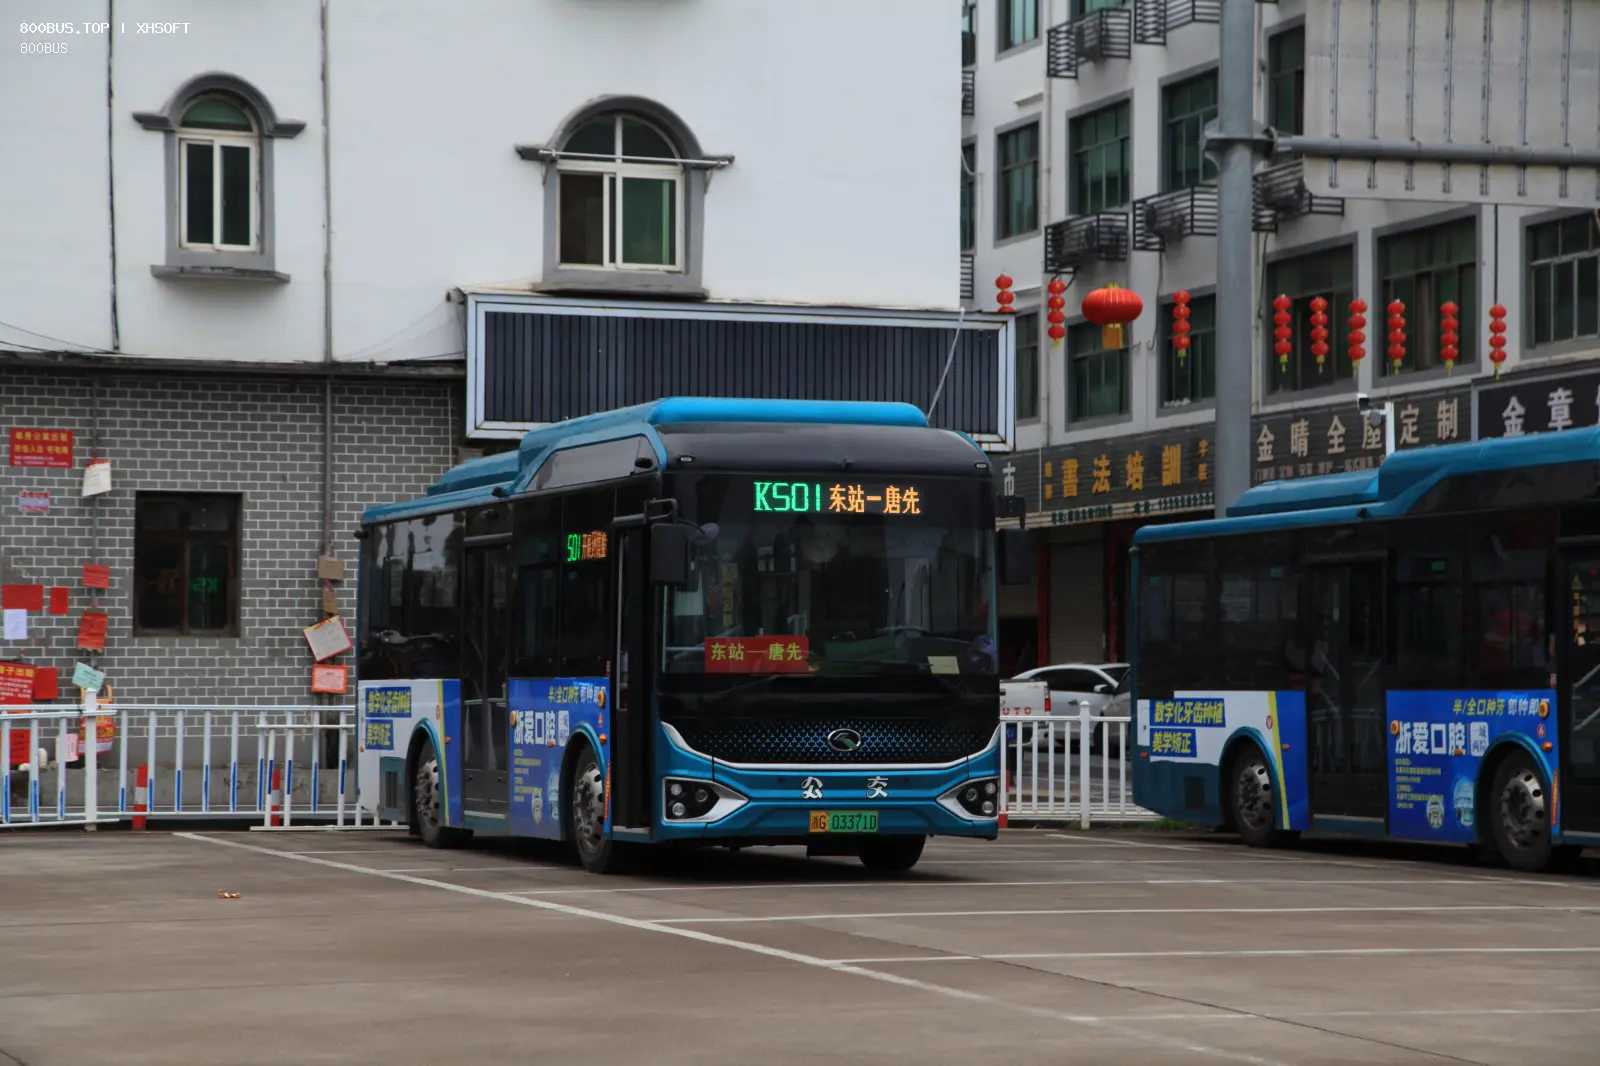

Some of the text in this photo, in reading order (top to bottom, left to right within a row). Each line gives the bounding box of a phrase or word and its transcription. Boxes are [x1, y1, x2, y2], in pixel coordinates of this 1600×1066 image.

[1501, 384, 1600, 437] 金章
[1154, 701, 1224, 724] 数字化牙齿种植
[1152, 731, 1192, 754] 美学矫正
[1395, 721, 1467, 756] 浙爱口腔
[801, 776, 889, 799] 公交
